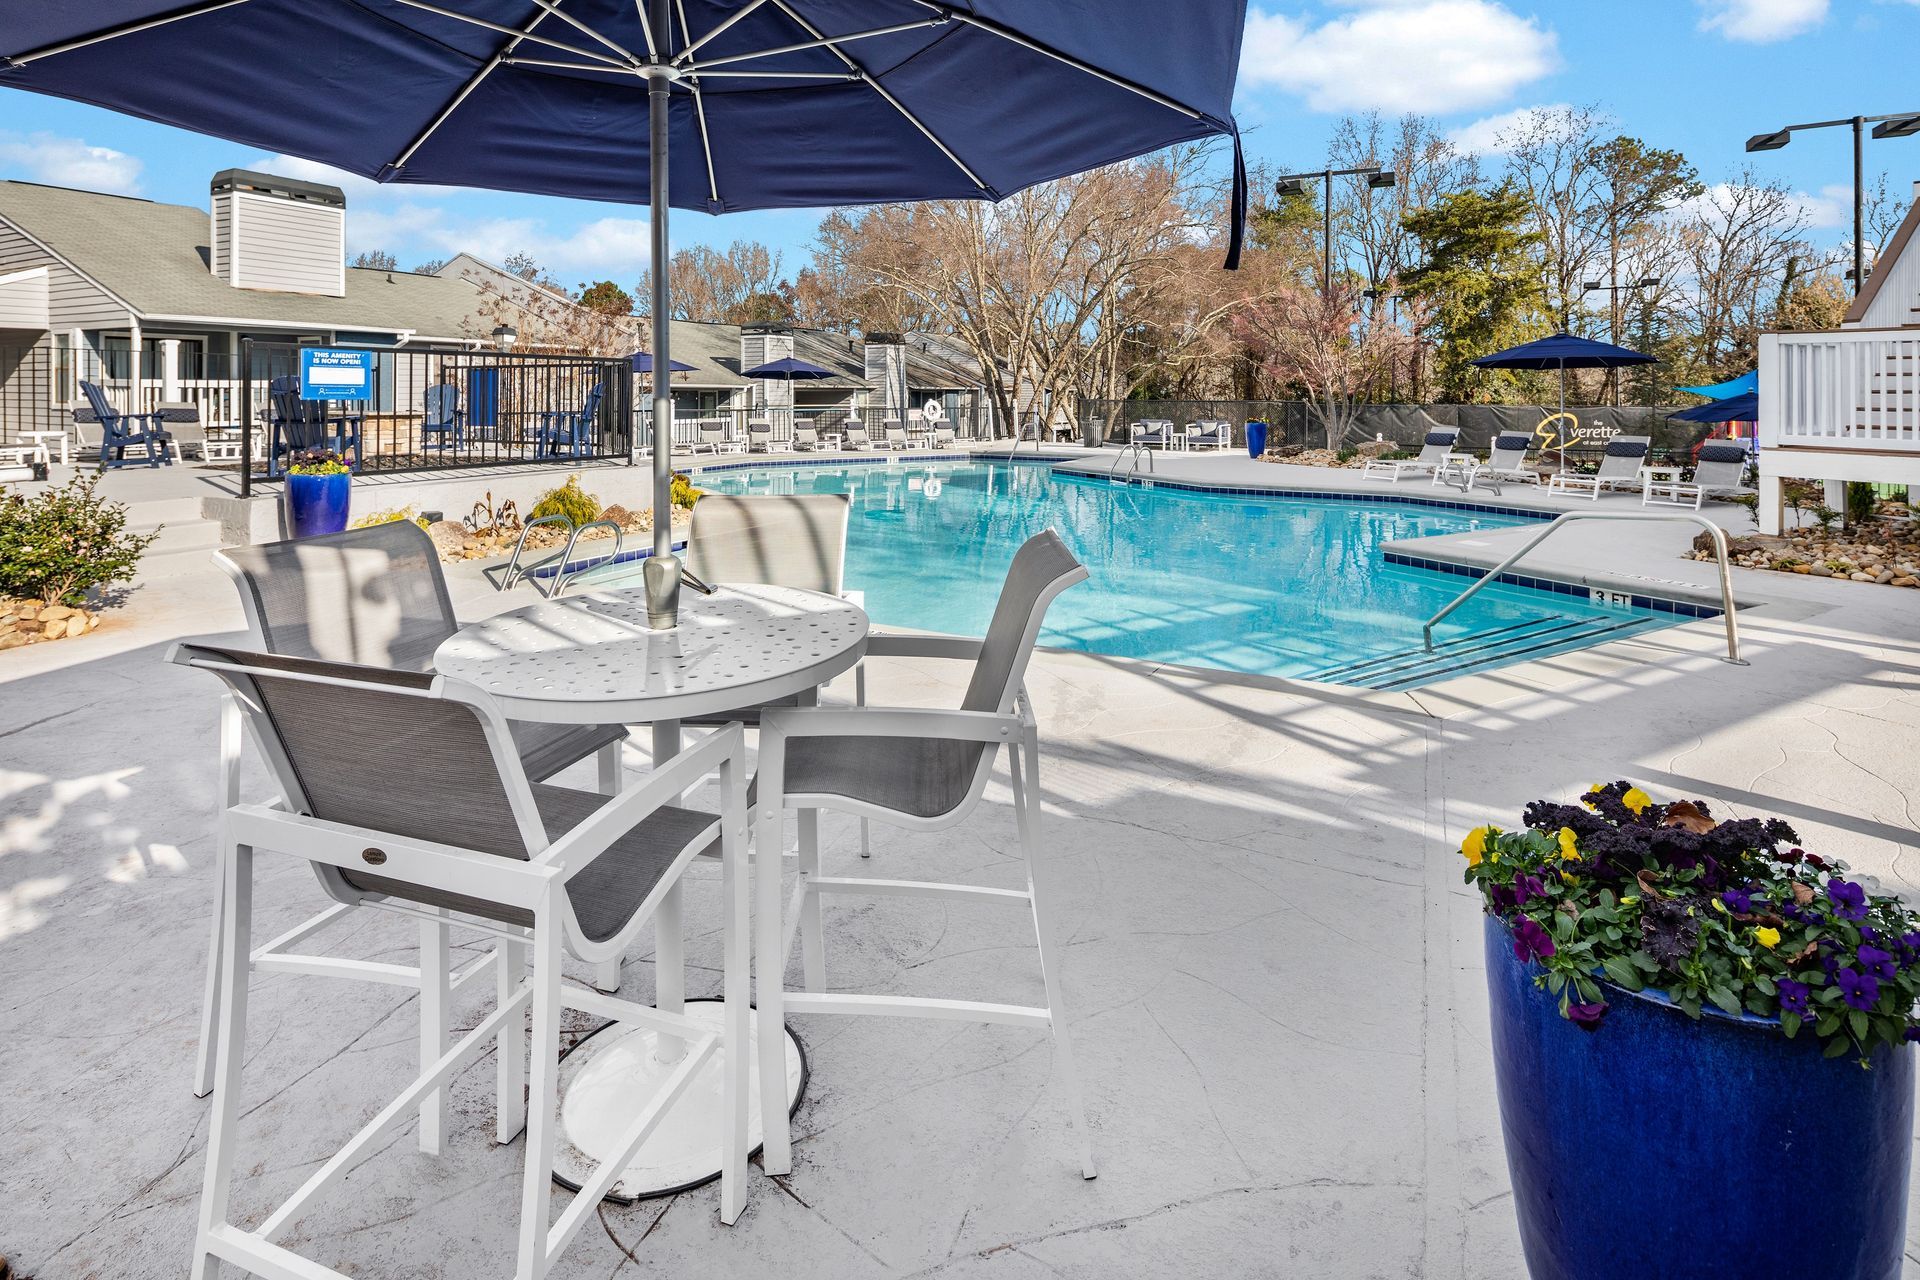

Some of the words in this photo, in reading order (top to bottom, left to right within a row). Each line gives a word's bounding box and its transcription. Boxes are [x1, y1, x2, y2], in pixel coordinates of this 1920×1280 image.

[330, 352, 362, 360] AMENITY
[1595, 590, 1605, 601] 3
[1611, 592, 1629, 605] FT
